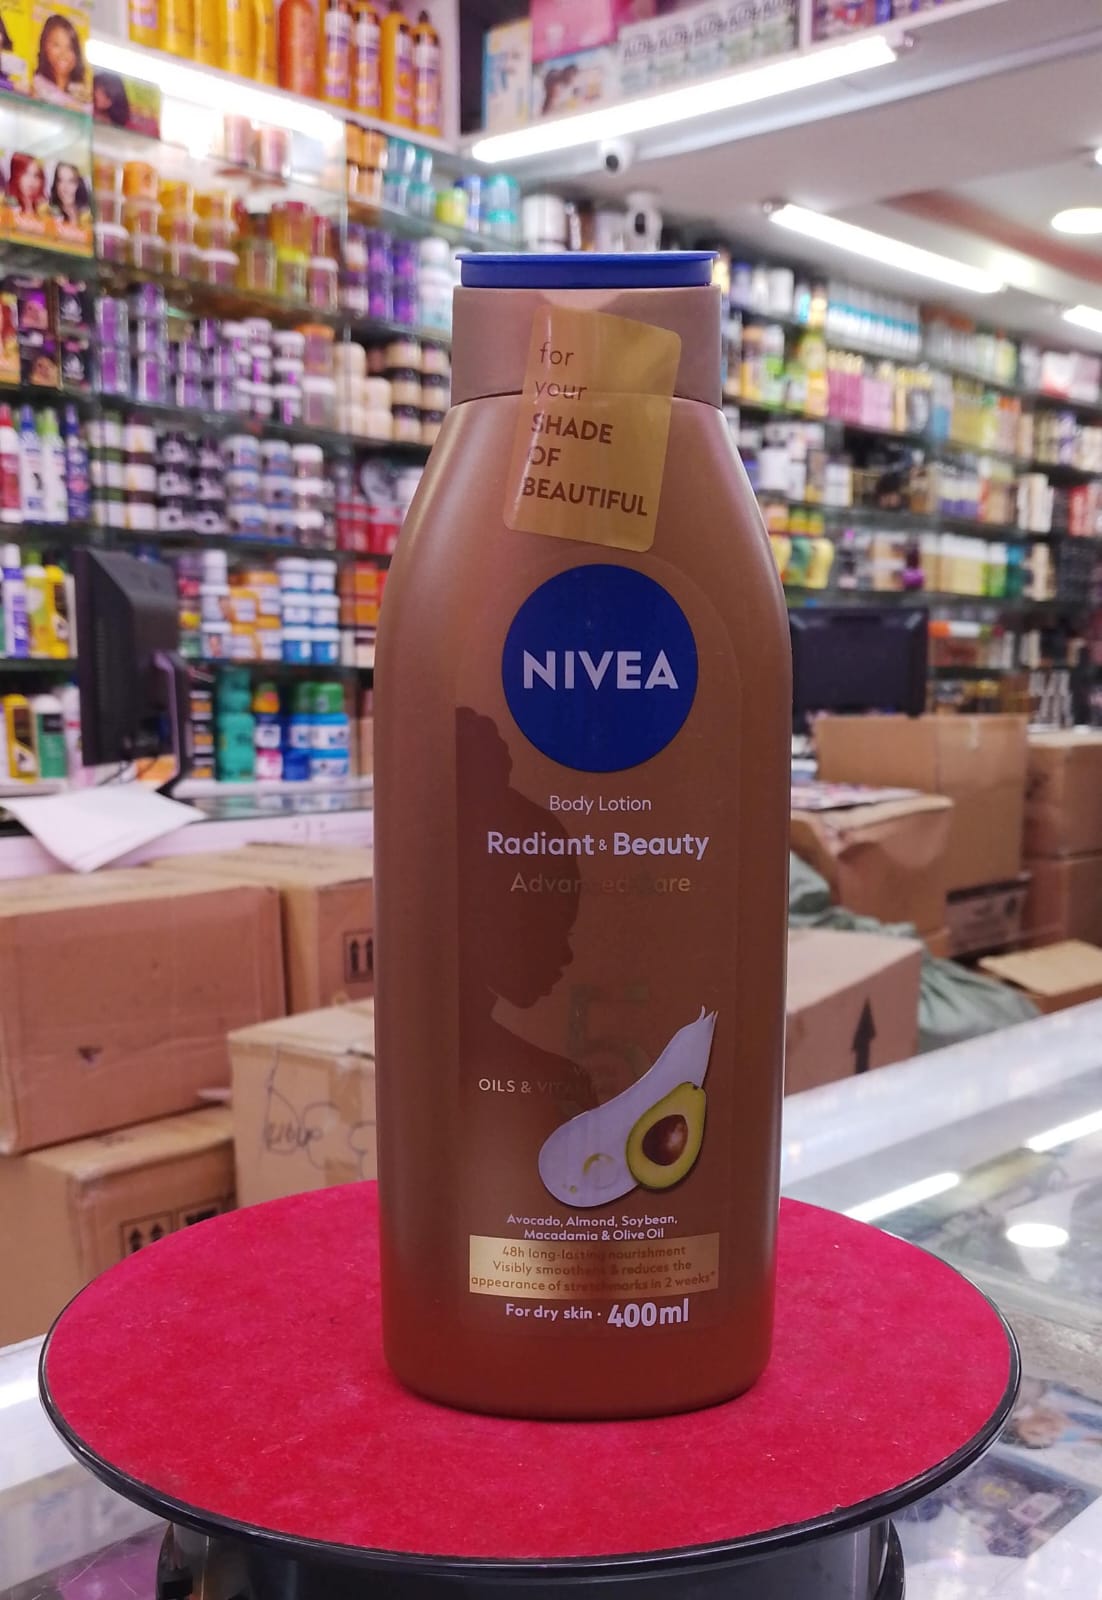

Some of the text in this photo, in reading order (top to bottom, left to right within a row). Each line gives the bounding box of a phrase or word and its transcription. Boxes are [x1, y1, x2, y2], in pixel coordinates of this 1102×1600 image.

[540, 341, 575, 367] for
[535, 381, 588, 402] your
[531, 412, 613, 444] SHADE
[528, 445, 561, 467] OF
[522, 476, 648, 516] BEAUTIFUL
[523, 649, 679, 691] NIVEA
[549, 795, 652, 815] Body Lotion
[487, 831, 710, 860] Radiant & Beauty
[639, 872, 691, 893] are
[478, 1078, 516, 1094] OILS
[520, 1080, 532, 1094] &
[506, 1213, 678, 1229] Avocado, Almond, Soybean,
[523, 1227, 664, 1241] Macadamia & Olive Oil
[502, 1245, 525, 1258] 48h
[608, 1245, 687, 1259] nourishment
[492, 1260, 532, 1275] Visibly
[622, 1261, 670, 1275] reduces
[673, 1259, 692, 1272] the
[471, 1276, 545, 1292] appearance
[548, 1279, 562, 1292] of
[651, 1277, 662, 1290] in
[665, 1276, 673, 1288] 2
[505, 1298, 689, 1328] For dry skin 400ml
